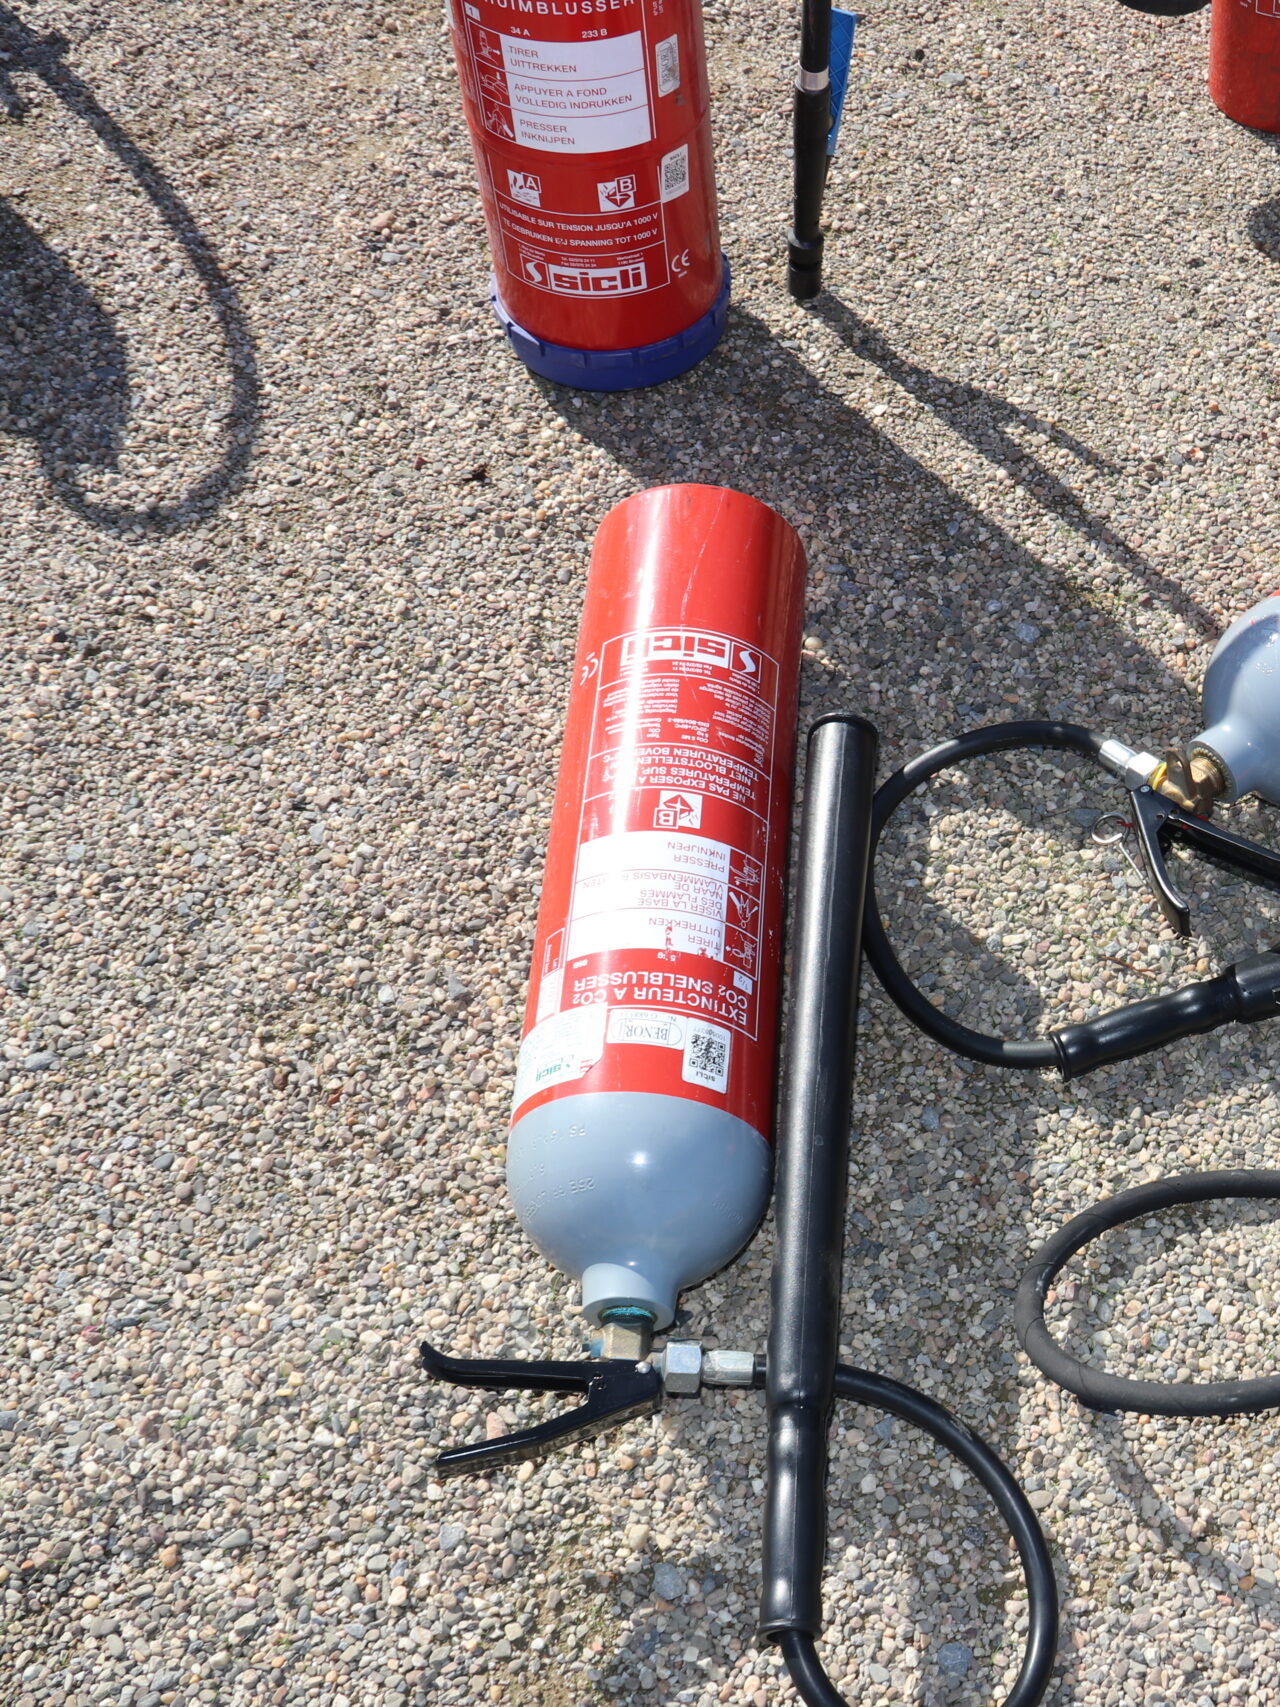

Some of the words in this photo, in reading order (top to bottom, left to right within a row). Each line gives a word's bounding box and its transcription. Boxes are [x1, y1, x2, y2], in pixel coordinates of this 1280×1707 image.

[510, 26, 520, 35] 34
[523, 29, 530, 37] A
[582, 30, 598, 38] 233
[601, 28, 608, 36] B
[508, 46, 539, 59] TIRER
[510, 58, 577, 73] UITTREKKEN
[514, 83, 563, 97] APPUYER
[566, 89, 573, 97] A
[576, 87, 607, 97] FOND
[515, 95, 567, 109] VOLLEDIG
[570, 94, 632, 109] INDRUKKEN
[519, 119, 567, 133] PRESSER
[521, 131, 575, 145] INKNIJPEN
[499, 202, 537, 225] UTILISABLE
[537, 219, 555, 229] SUR
[556, 223, 593, 232] TENSION
[595, 221, 632, 232] JUSQU'A
[633, 215, 652, 226] 1000
[511, 223, 554, 244] GEBRUIKEN
[570, 239, 613, 247] SPANNING
[615, 236, 632, 245] TOT
[633, 230, 651, 241] 1000
[552, 266, 642, 291] sicli
[632, 747, 670, 756] BOVE
[638, 756, 726, 774] BLOOTSTELLEN
[641, 767, 667, 775] SUP.
[673, 748, 759, 782] TEMPERATUREN
[649, 775, 706, 788] EXPOSER
[670, 767, 756, 800] TEMPERATURES
[729, 770, 751, 786] NIET
[708, 783, 730, 796] PAS
[732, 791, 746, 803] NE
[667, 841, 726, 861] INKNIJPEN
[673, 854, 725, 873] PRESSER
[632, 872, 724, 892] VLAMMENBASIS
[674, 881, 689, 891] DE
[640, 889, 697, 903] FLAMMES
[693, 886, 723, 900] NAAR
[637, 898, 669, 906] BASE
[672, 900, 687, 909] LA
[701, 896, 722, 910] DES
[690, 903, 722, 918] VISER
[649, 918, 720, 938] UITTREKKEN
[687, 934, 720, 950] TIRER
[574, 970, 713, 995] SNELBLUSSER
[572, 988, 607, 1005] CO2
[614, 987, 627, 1000] A
[718, 985, 748, 1009] CO2
[633, 987, 747, 1026] EXTINCTEUR
[624, 1024, 668, 1041] BENOR
